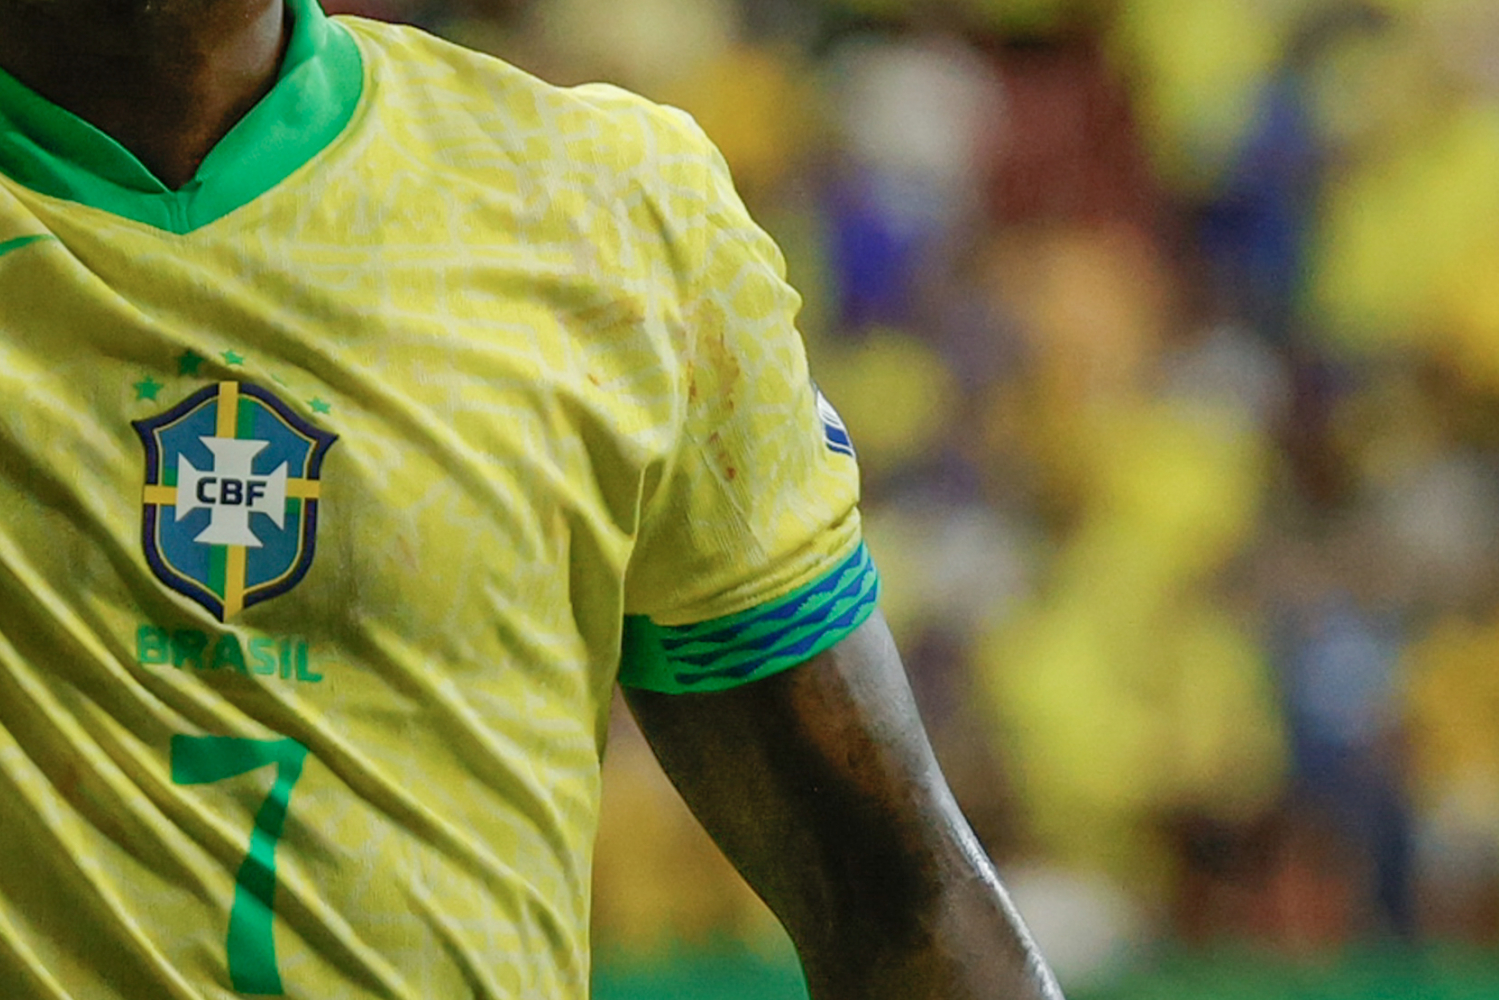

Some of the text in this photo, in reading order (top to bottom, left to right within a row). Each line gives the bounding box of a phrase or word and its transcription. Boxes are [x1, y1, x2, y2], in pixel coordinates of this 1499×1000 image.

[195, 476, 268, 507] CBF
[136, 625, 323, 682] BRASIL
[170, 733, 309, 995] 7
